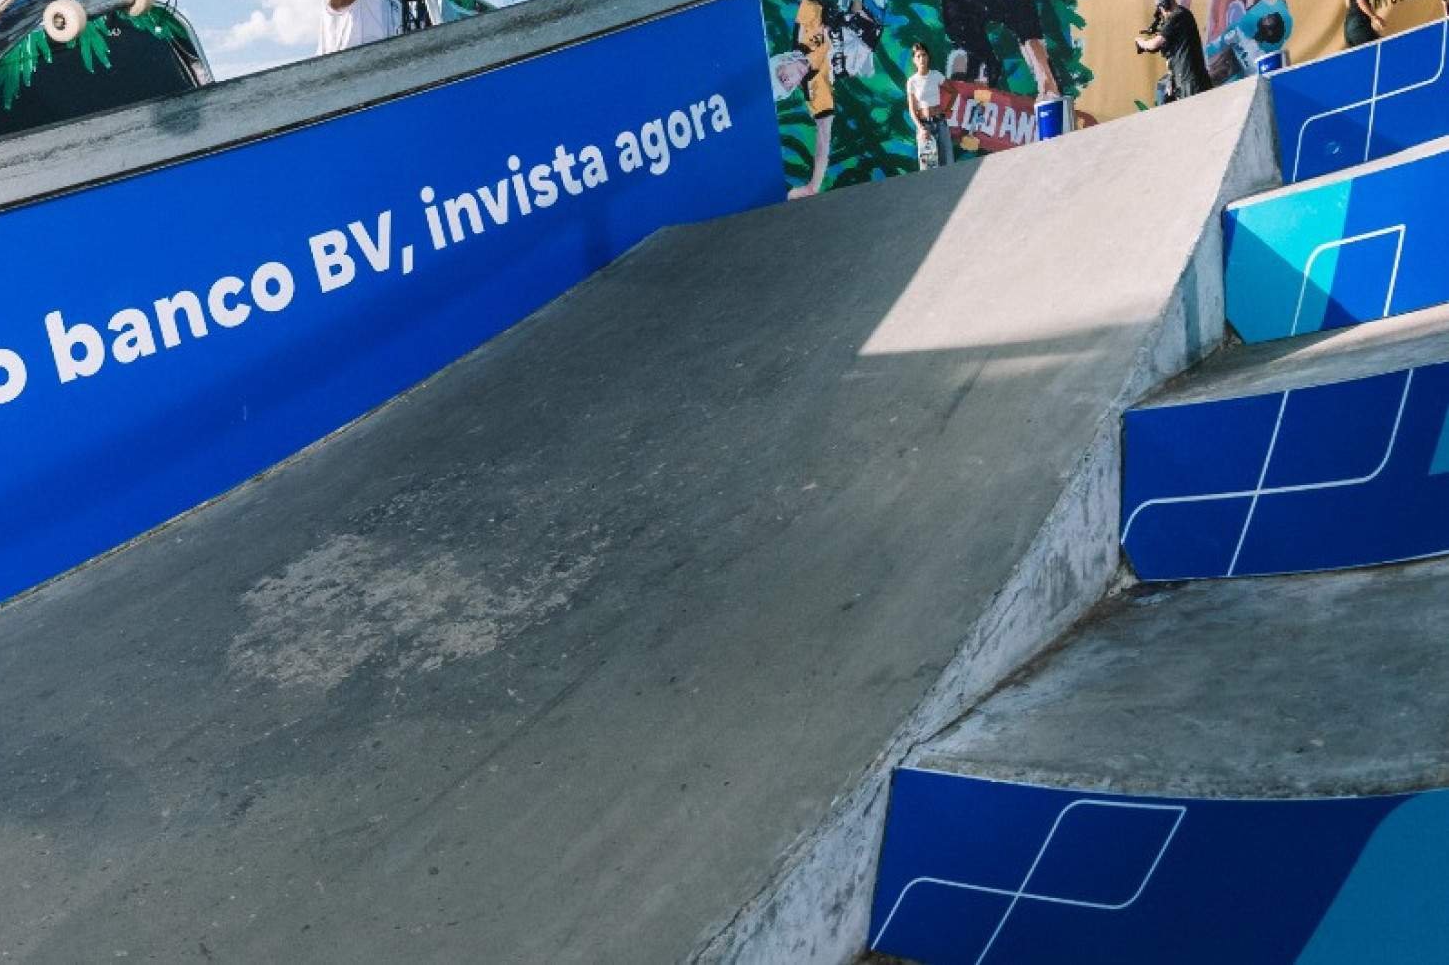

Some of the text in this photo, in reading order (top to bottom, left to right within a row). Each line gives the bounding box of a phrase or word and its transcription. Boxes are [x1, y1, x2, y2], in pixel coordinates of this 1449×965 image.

[45, 262, 294, 383] banco
[309, 211, 413, 292] BV,
[421, 146, 607, 250] invista
[616, 95, 732, 174] agora
